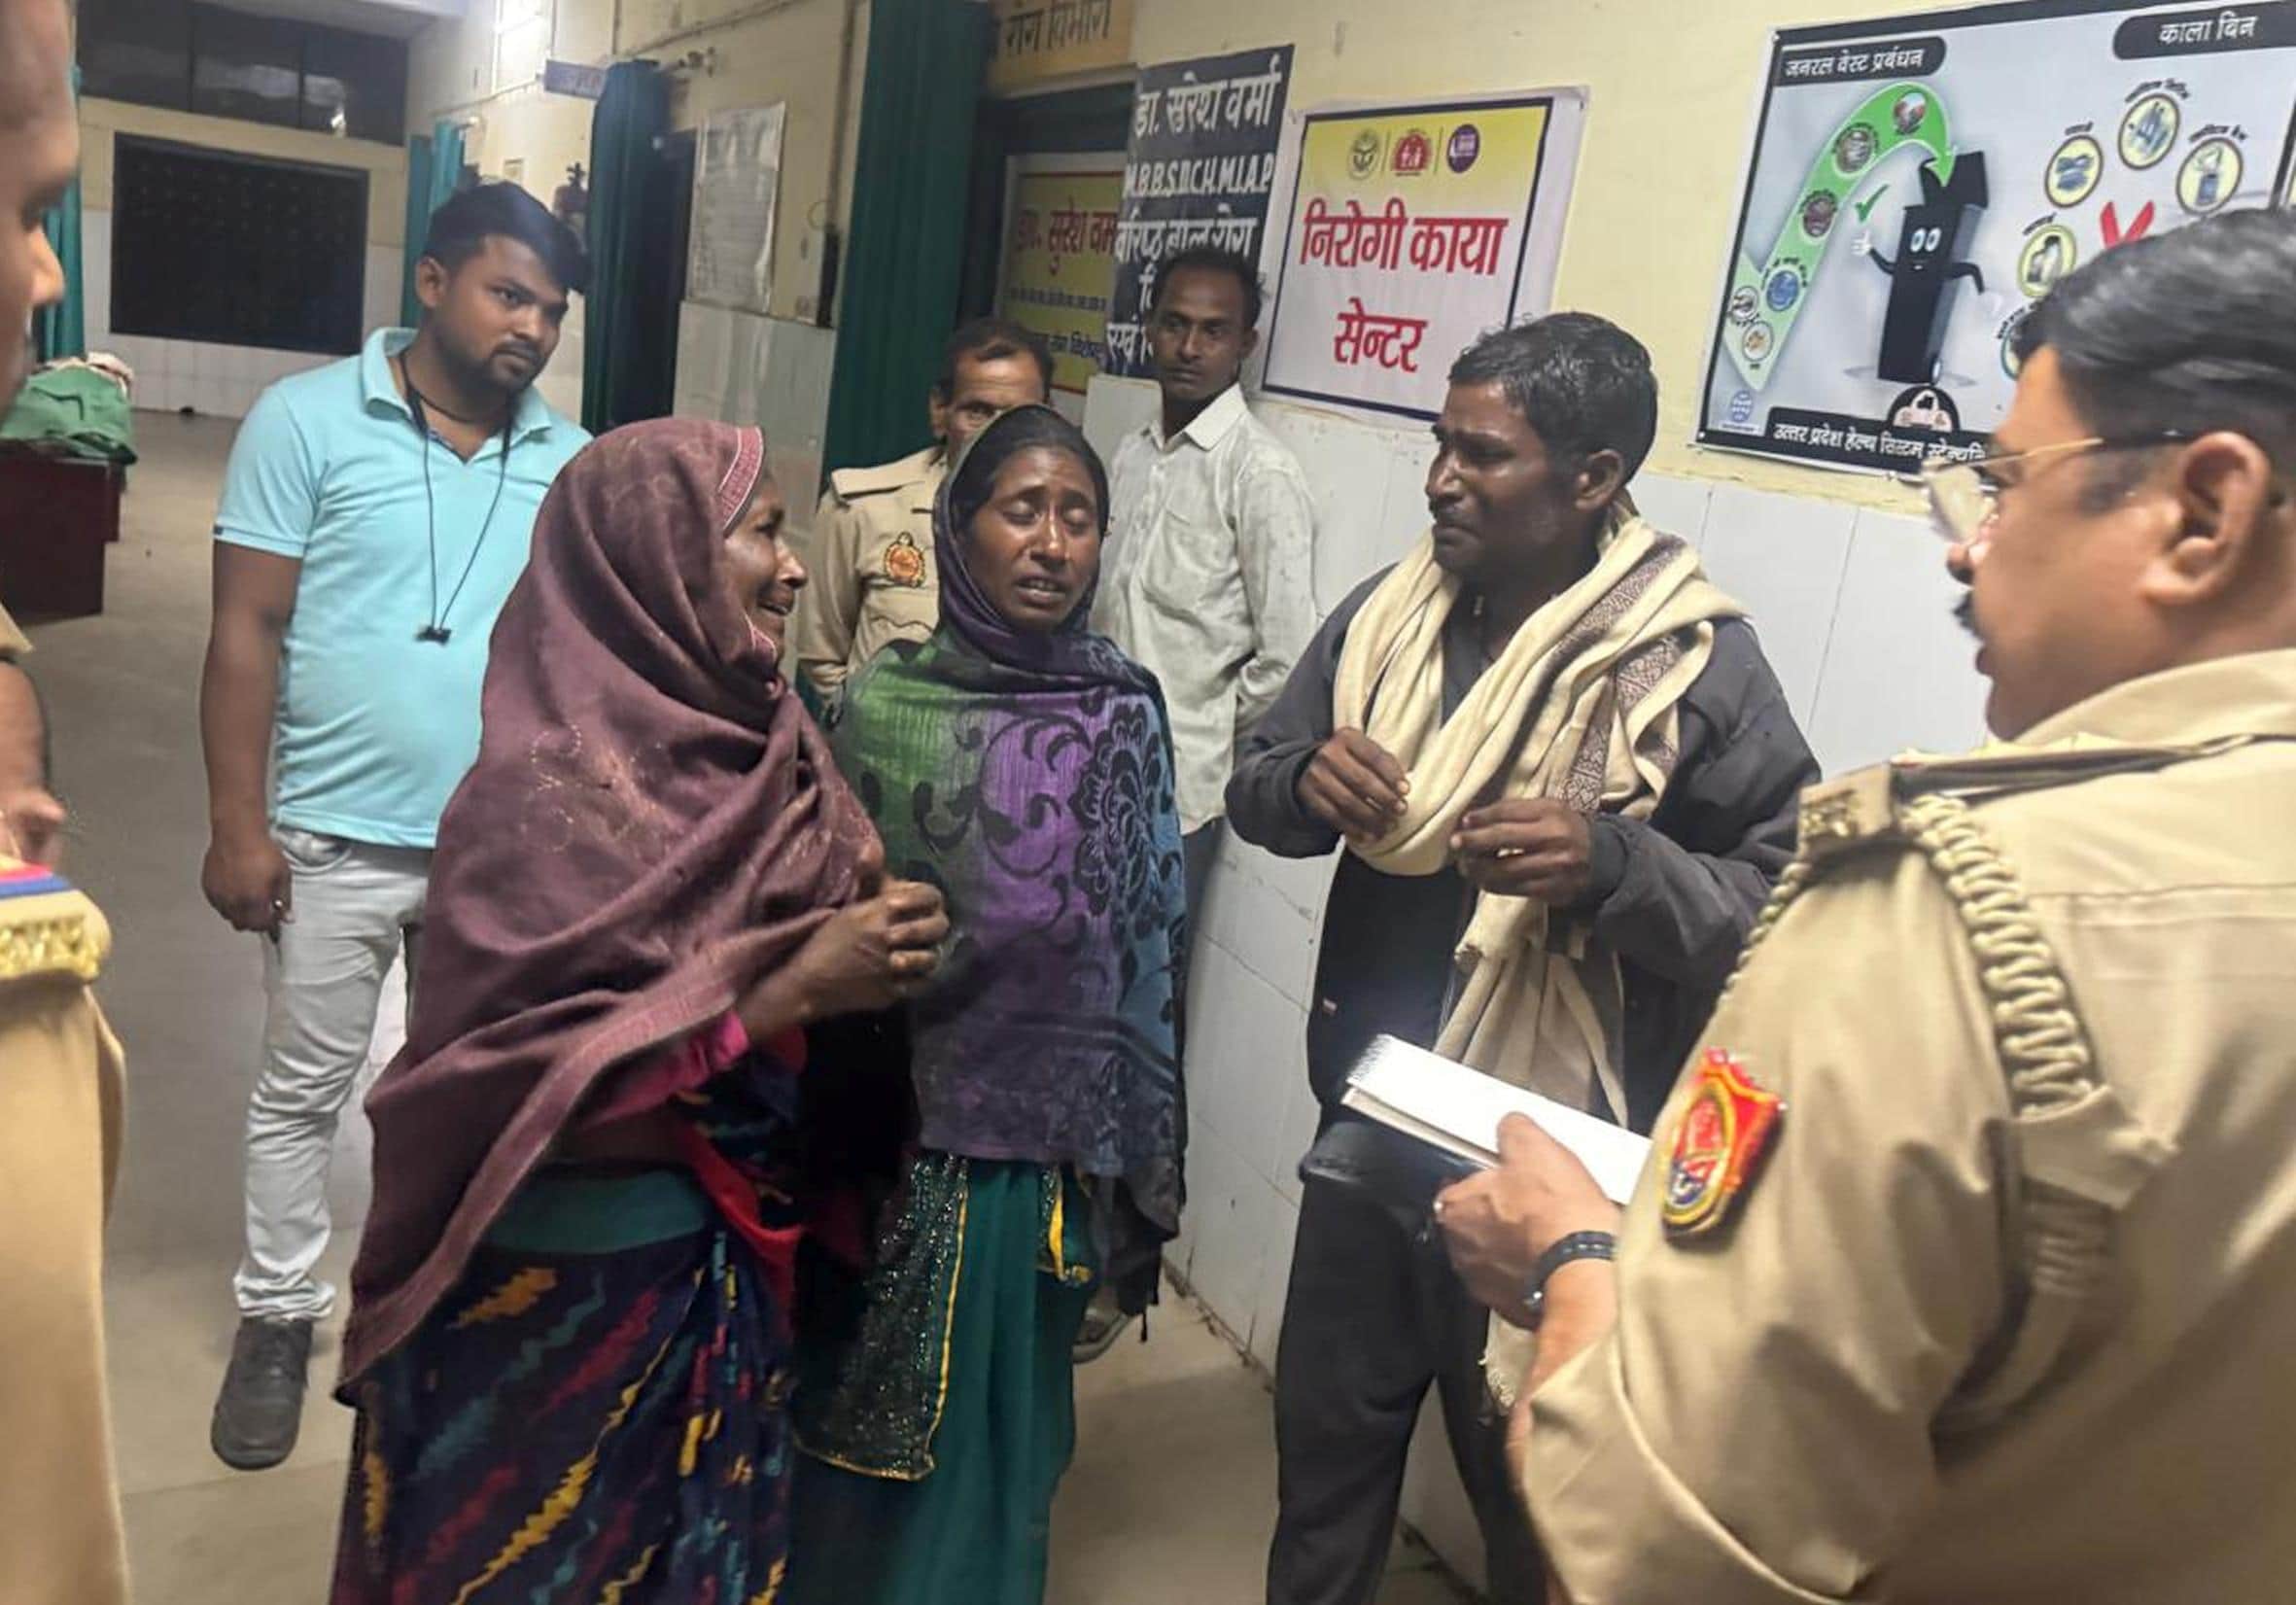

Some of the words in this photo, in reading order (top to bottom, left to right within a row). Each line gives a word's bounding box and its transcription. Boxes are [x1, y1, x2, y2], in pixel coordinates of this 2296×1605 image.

[2157, 19, 2212, 45] काला
[2215, 10, 2258, 40] बिन
[1785, 56, 1833, 78] जनरल
[1836, 50, 1870, 74] वेस्ट
[1870, 45, 1925, 73] प्रबंधन
[1224, 53, 1282, 128] वर्मा
[1212, 203, 1259, 259] रोग
[1300, 196, 1408, 270] निरोगी
[1409, 218, 1510, 276] काया
[1334, 297, 1428, 373] सेन्टर
[1773, 423, 1807, 442] उत्तर
[1808, 422, 1844, 448] प्रदेश
[1844, 426, 1877, 452] हेल्थ
